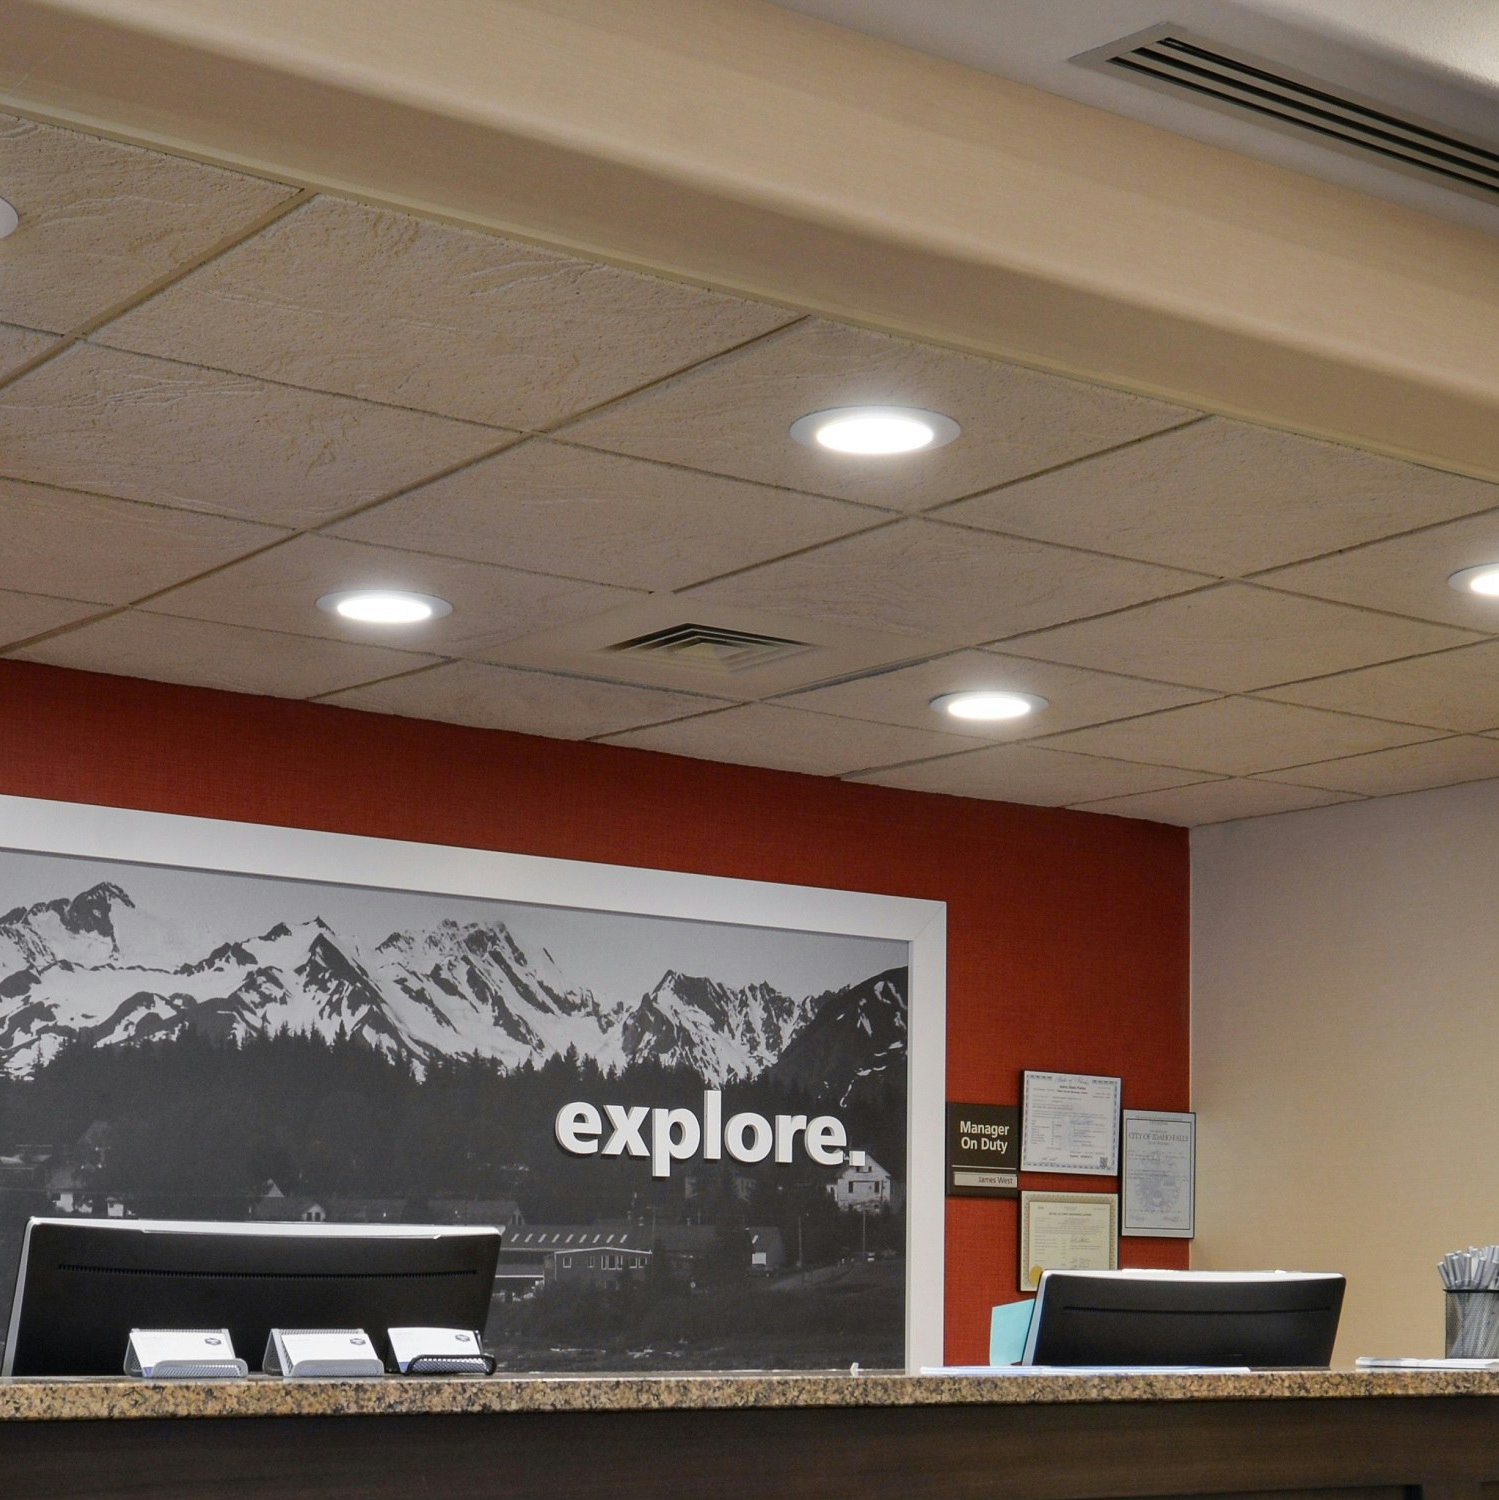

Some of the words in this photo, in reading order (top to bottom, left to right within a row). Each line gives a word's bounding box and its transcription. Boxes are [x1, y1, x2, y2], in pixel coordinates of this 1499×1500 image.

[555, 1090, 865, 1177] explore.
[960, 1120, 1009, 1138] Manager
[961, 1136, 978, 1150] On
[981, 1137, 1008, 1154] Duty
[978, 1176, 996, 1184] James
[998, 1177, 1013, 1185] West
